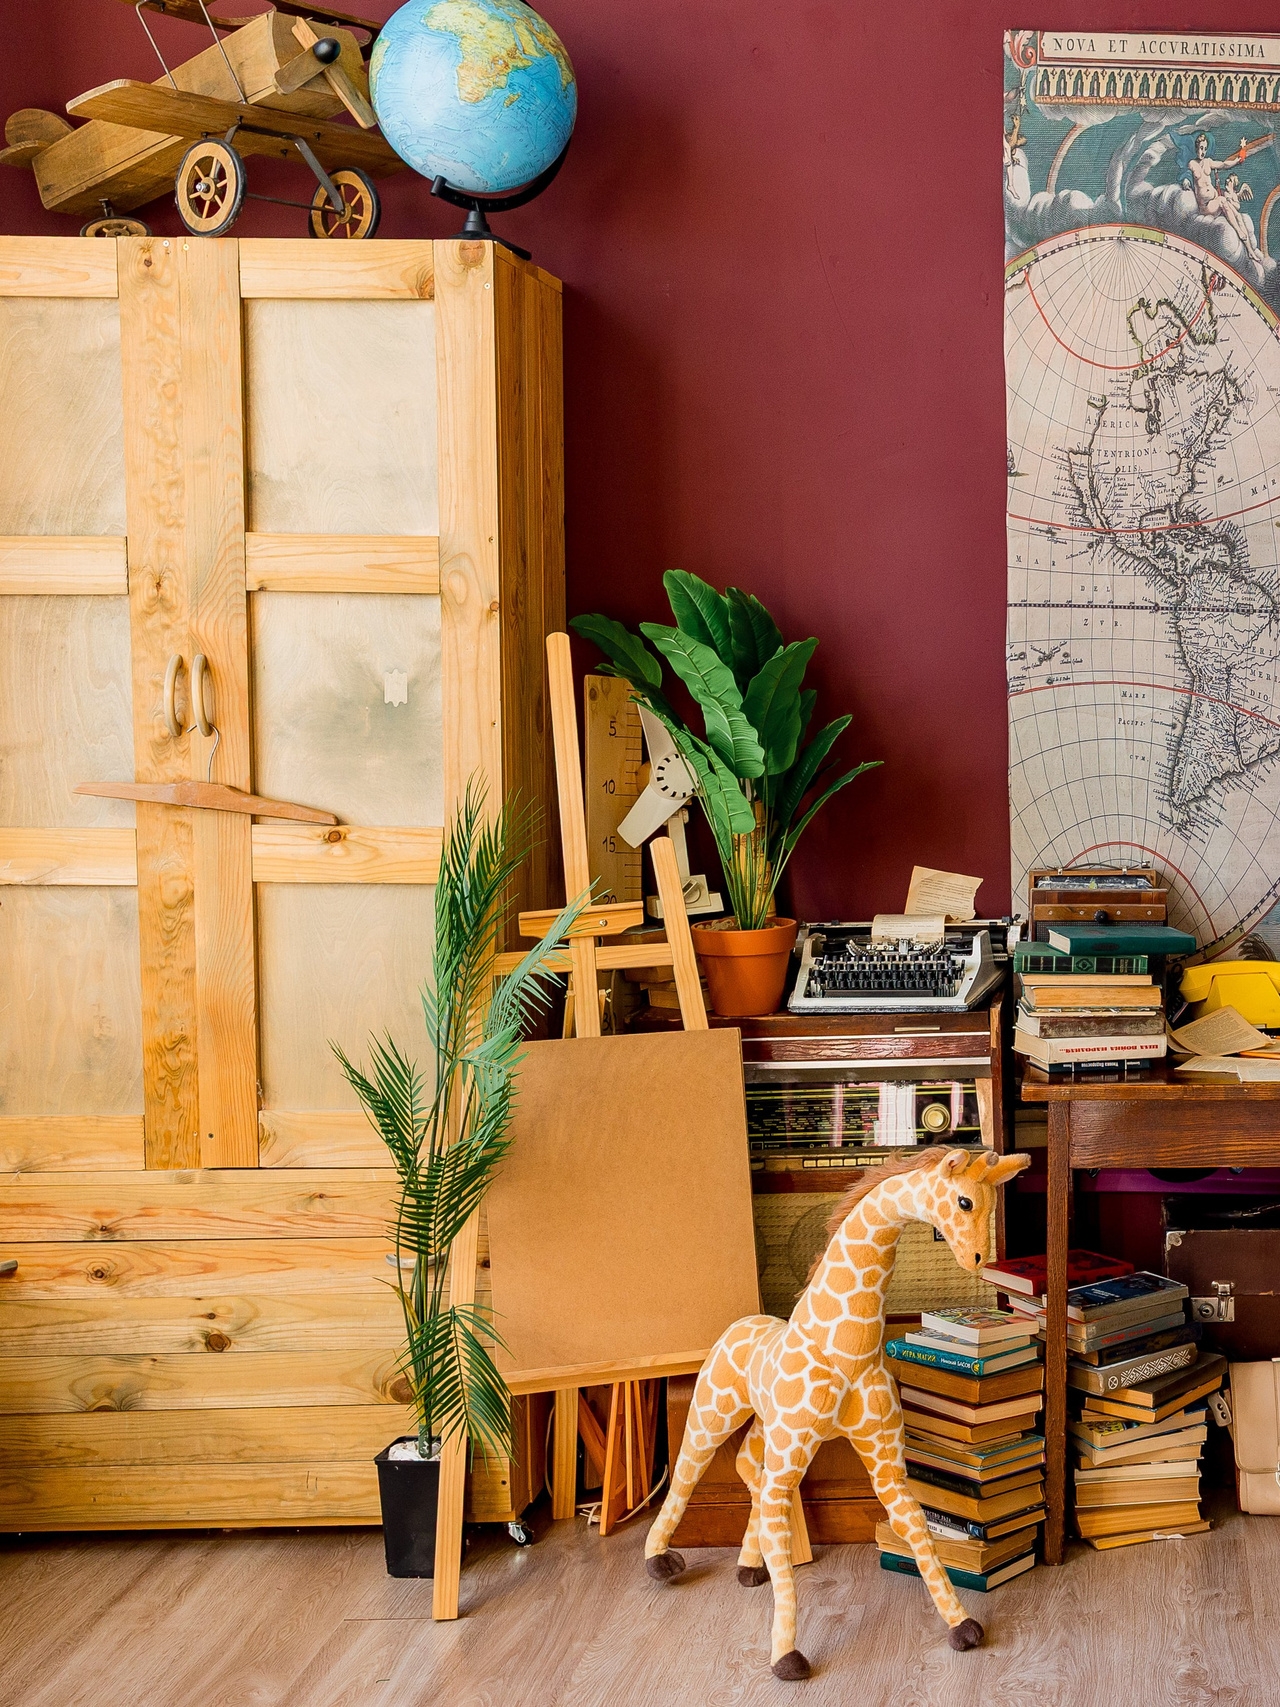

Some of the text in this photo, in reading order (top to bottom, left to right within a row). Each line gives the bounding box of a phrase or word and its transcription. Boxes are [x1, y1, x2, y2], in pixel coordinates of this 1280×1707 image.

[1053, 37, 1097, 53] NOVA
[1107, 38, 1129, 53] ET
[1137, 40, 1266, 58] ACCVRATISSIMA
[608, 720, 617, 737] 5
[602, 779, 616, 795] 10
[602, 835, 616, 853] 15
[902, 1349, 916, 1359] ИГРА
[916, 1352, 936, 1363] МАГИЙ
[956, 1360, 971, 1369] БАСОВ
